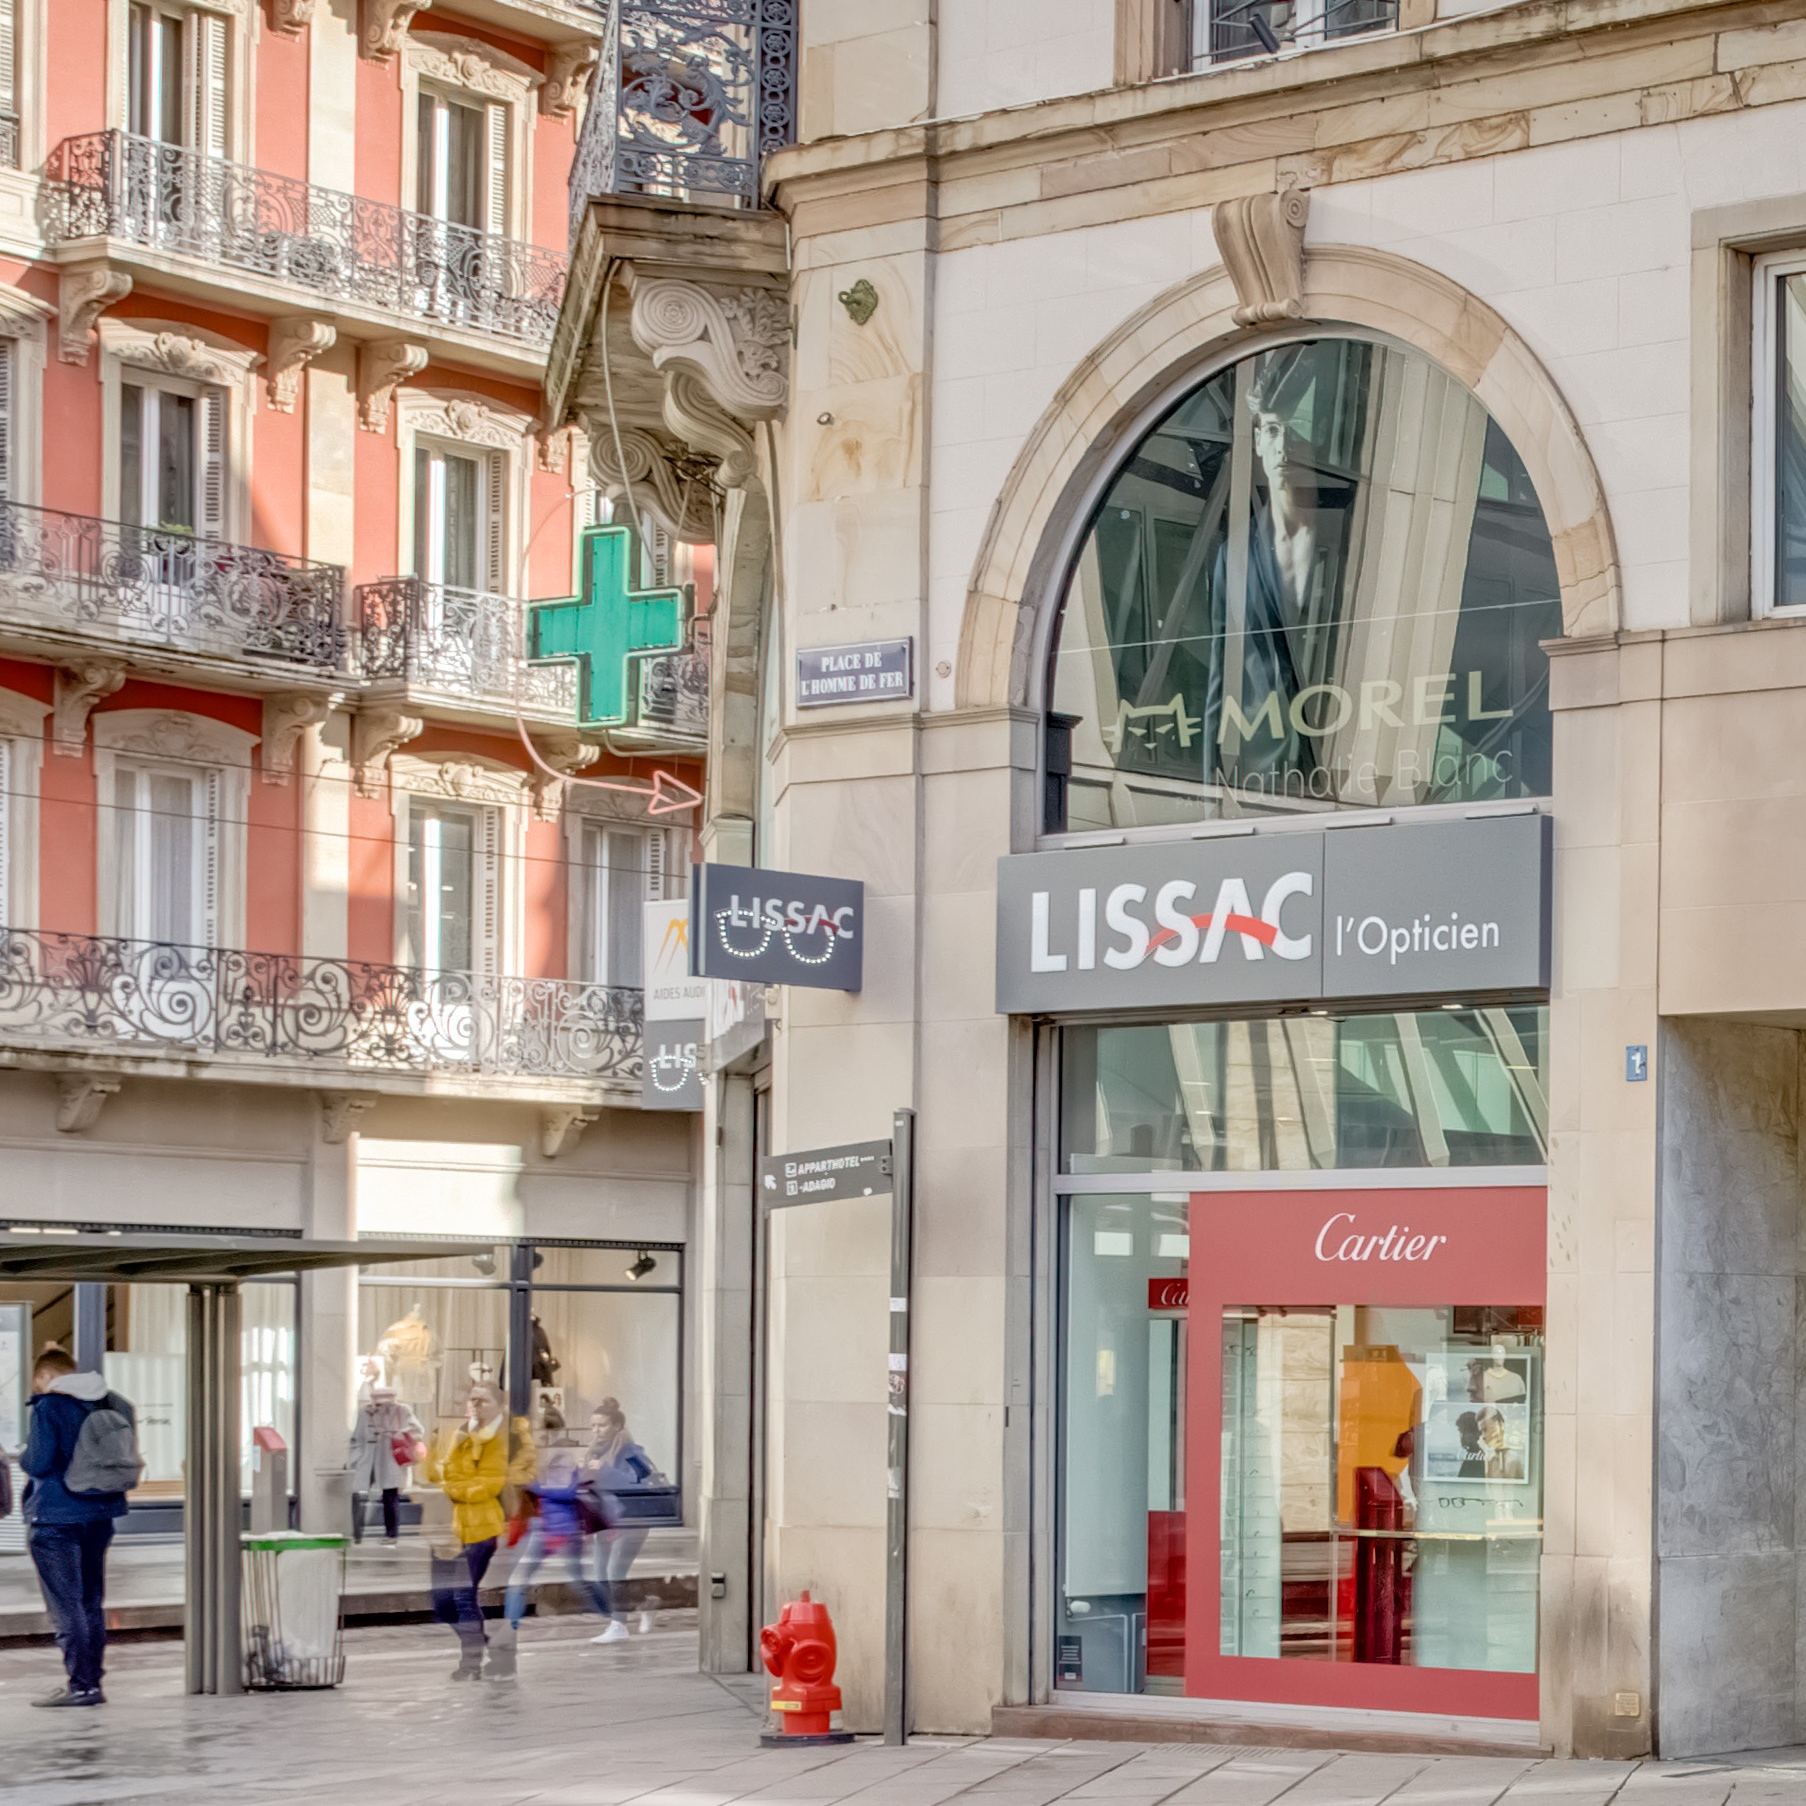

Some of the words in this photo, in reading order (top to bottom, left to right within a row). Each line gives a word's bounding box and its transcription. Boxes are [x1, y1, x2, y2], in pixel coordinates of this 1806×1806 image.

[821, 654, 861, 672] PLACE
[865, 652, 882, 669] DE
[860, 674, 876, 690] DE
[880, 672, 903, 689] FER
[1217, 670, 1514, 745] MOREL
[1216, 757, 1379, 804] Nathalie
[1398, 749, 1514, 791] Blanc
[731, 894, 854, 939] LISSAC
[1031, 872, 1314, 973] LISSAC
[1336, 912, 1501, 965] l'Opticien
[1315, 1213, 1447, 1262] Cartier
